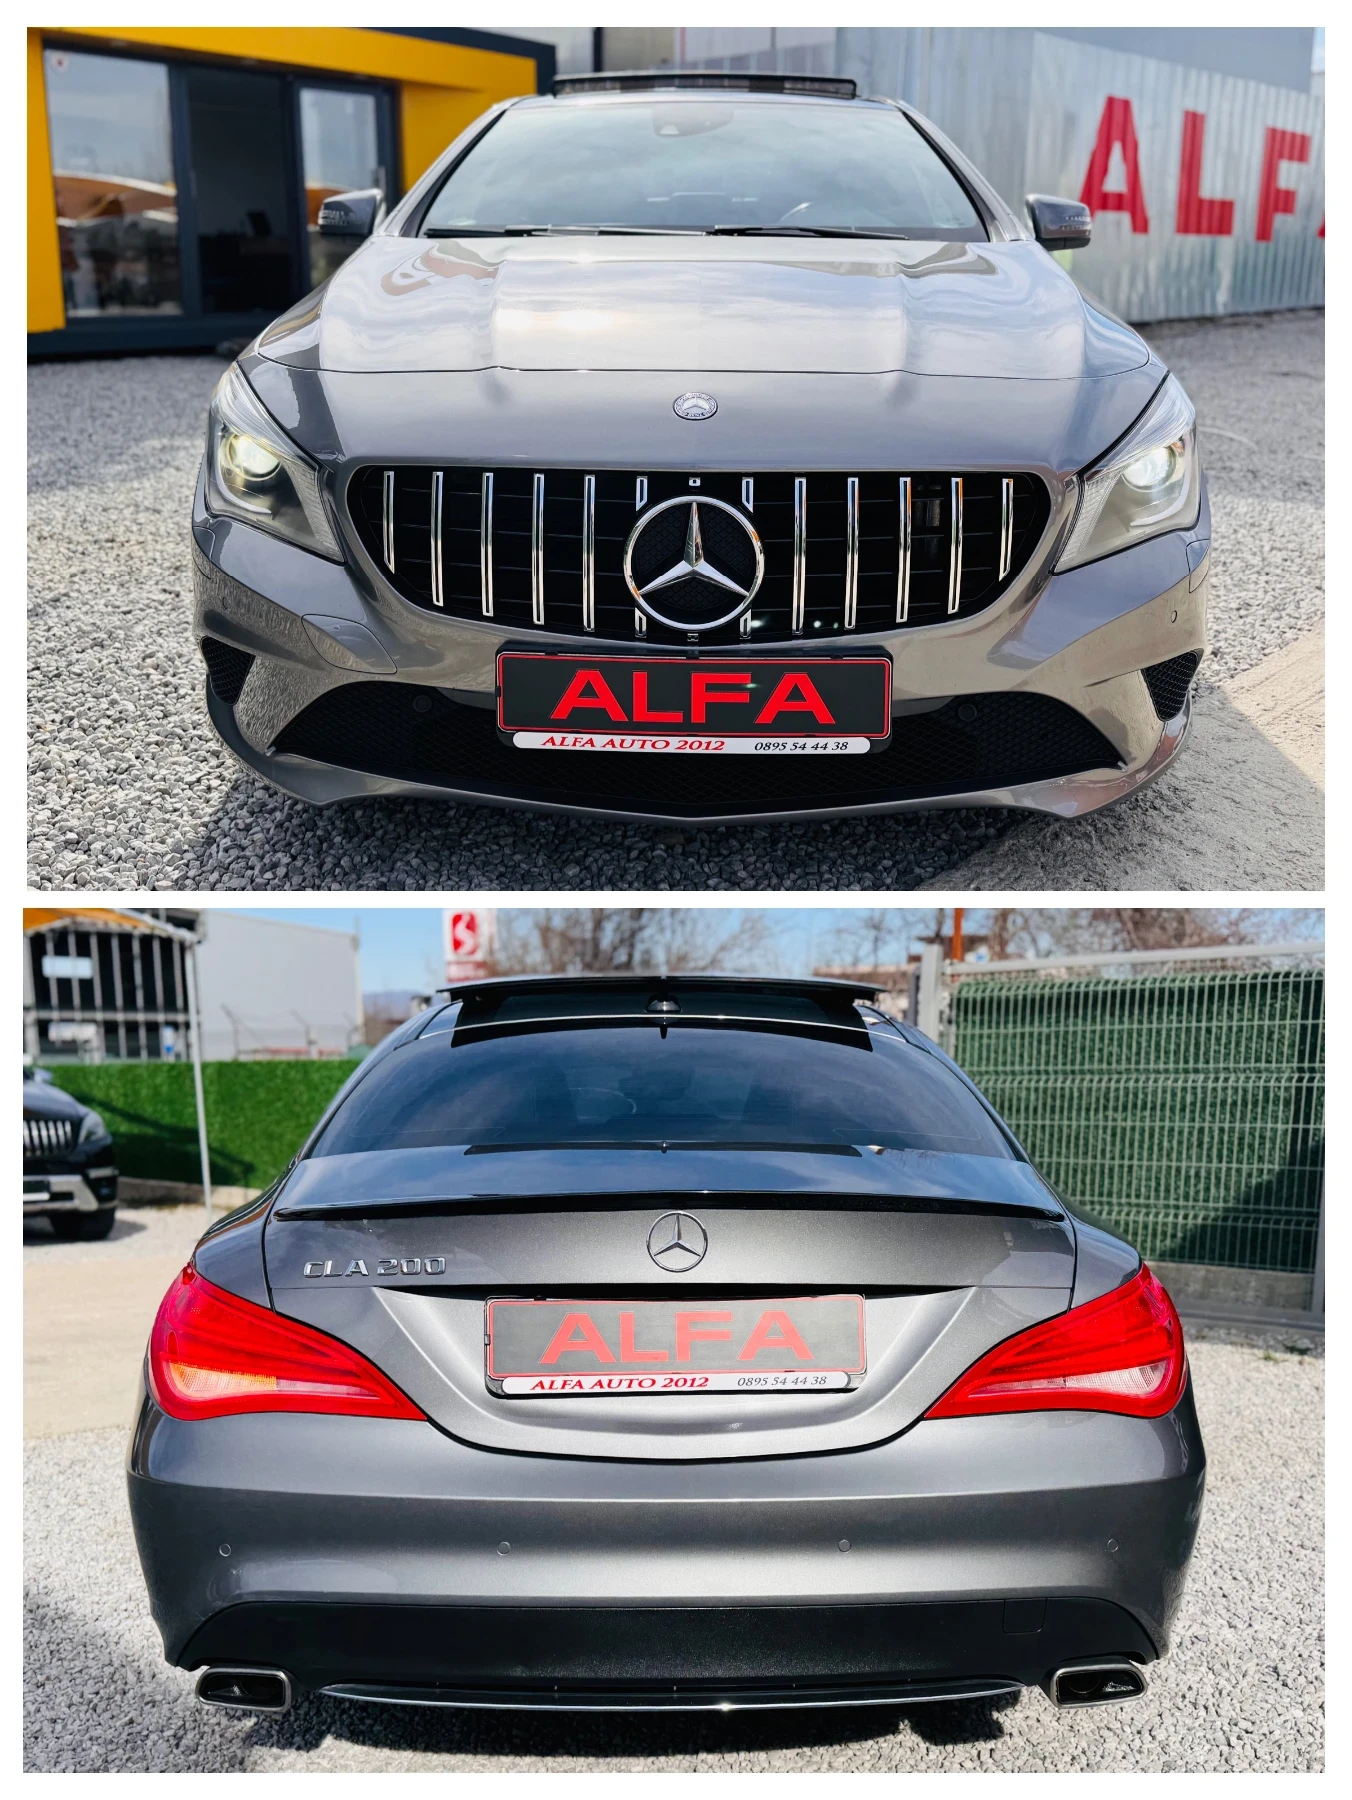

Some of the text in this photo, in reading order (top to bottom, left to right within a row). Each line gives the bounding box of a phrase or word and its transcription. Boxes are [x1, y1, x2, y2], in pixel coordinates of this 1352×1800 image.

[1079, 96, 1325, 242] ALF
[550, 668, 836, 724] ALFA
[541, 736, 849, 752] ALFA AUTO 2012 0895 54 44 38
[303, 1257, 446, 1278] CLA 200
[540, 1309, 814, 1364] ALFA
[529, 1375, 827, 1391] ALFA AUTO 2012 0895 54 44 38
